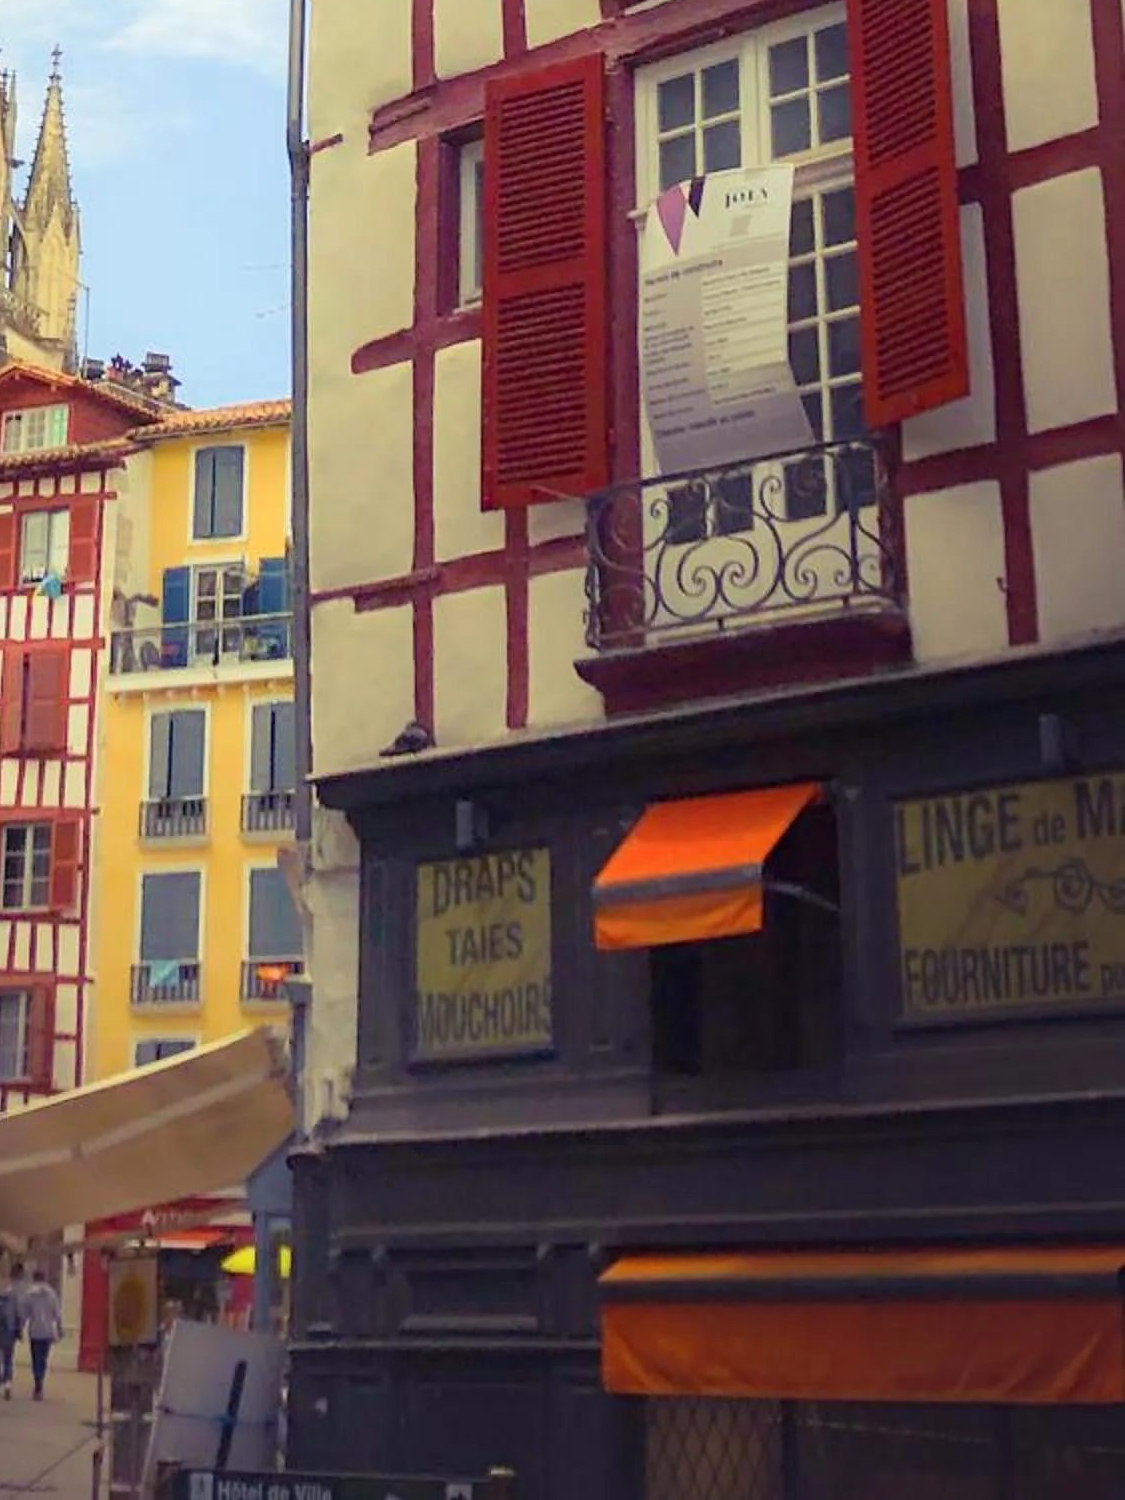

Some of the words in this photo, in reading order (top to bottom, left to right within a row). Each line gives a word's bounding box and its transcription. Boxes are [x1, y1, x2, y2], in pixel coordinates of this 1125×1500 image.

[896, 793, 1021, 875] LINGE
[1033, 810, 1065, 845] de
[433, 853, 536, 917] DRAPS
[445, 921, 524, 966] TAIES
[904, 942, 1090, 1006] FOURNITURE
[217, 1479, 263, 1500] Hôtel
[268, 1484, 290, 1500] de
[295, 1482, 332, 1500] Ville
